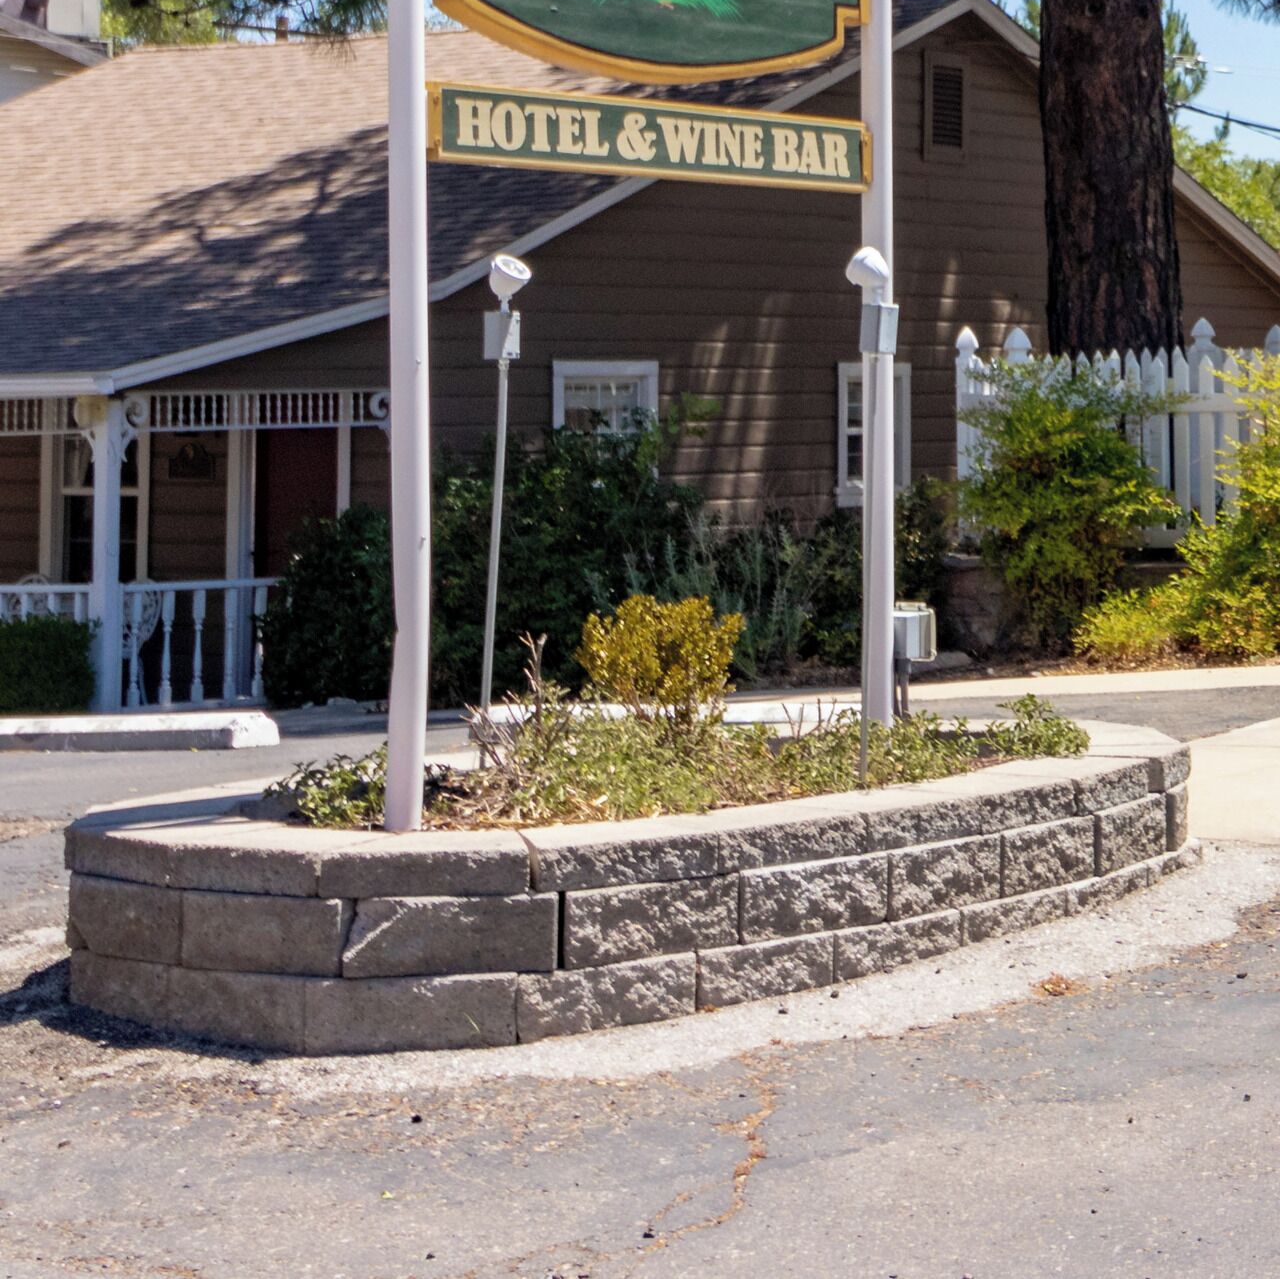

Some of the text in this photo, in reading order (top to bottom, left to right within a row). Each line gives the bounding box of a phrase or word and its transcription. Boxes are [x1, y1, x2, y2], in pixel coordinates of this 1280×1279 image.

[455, 96, 851, 178] HOTEL & WINE BAR
